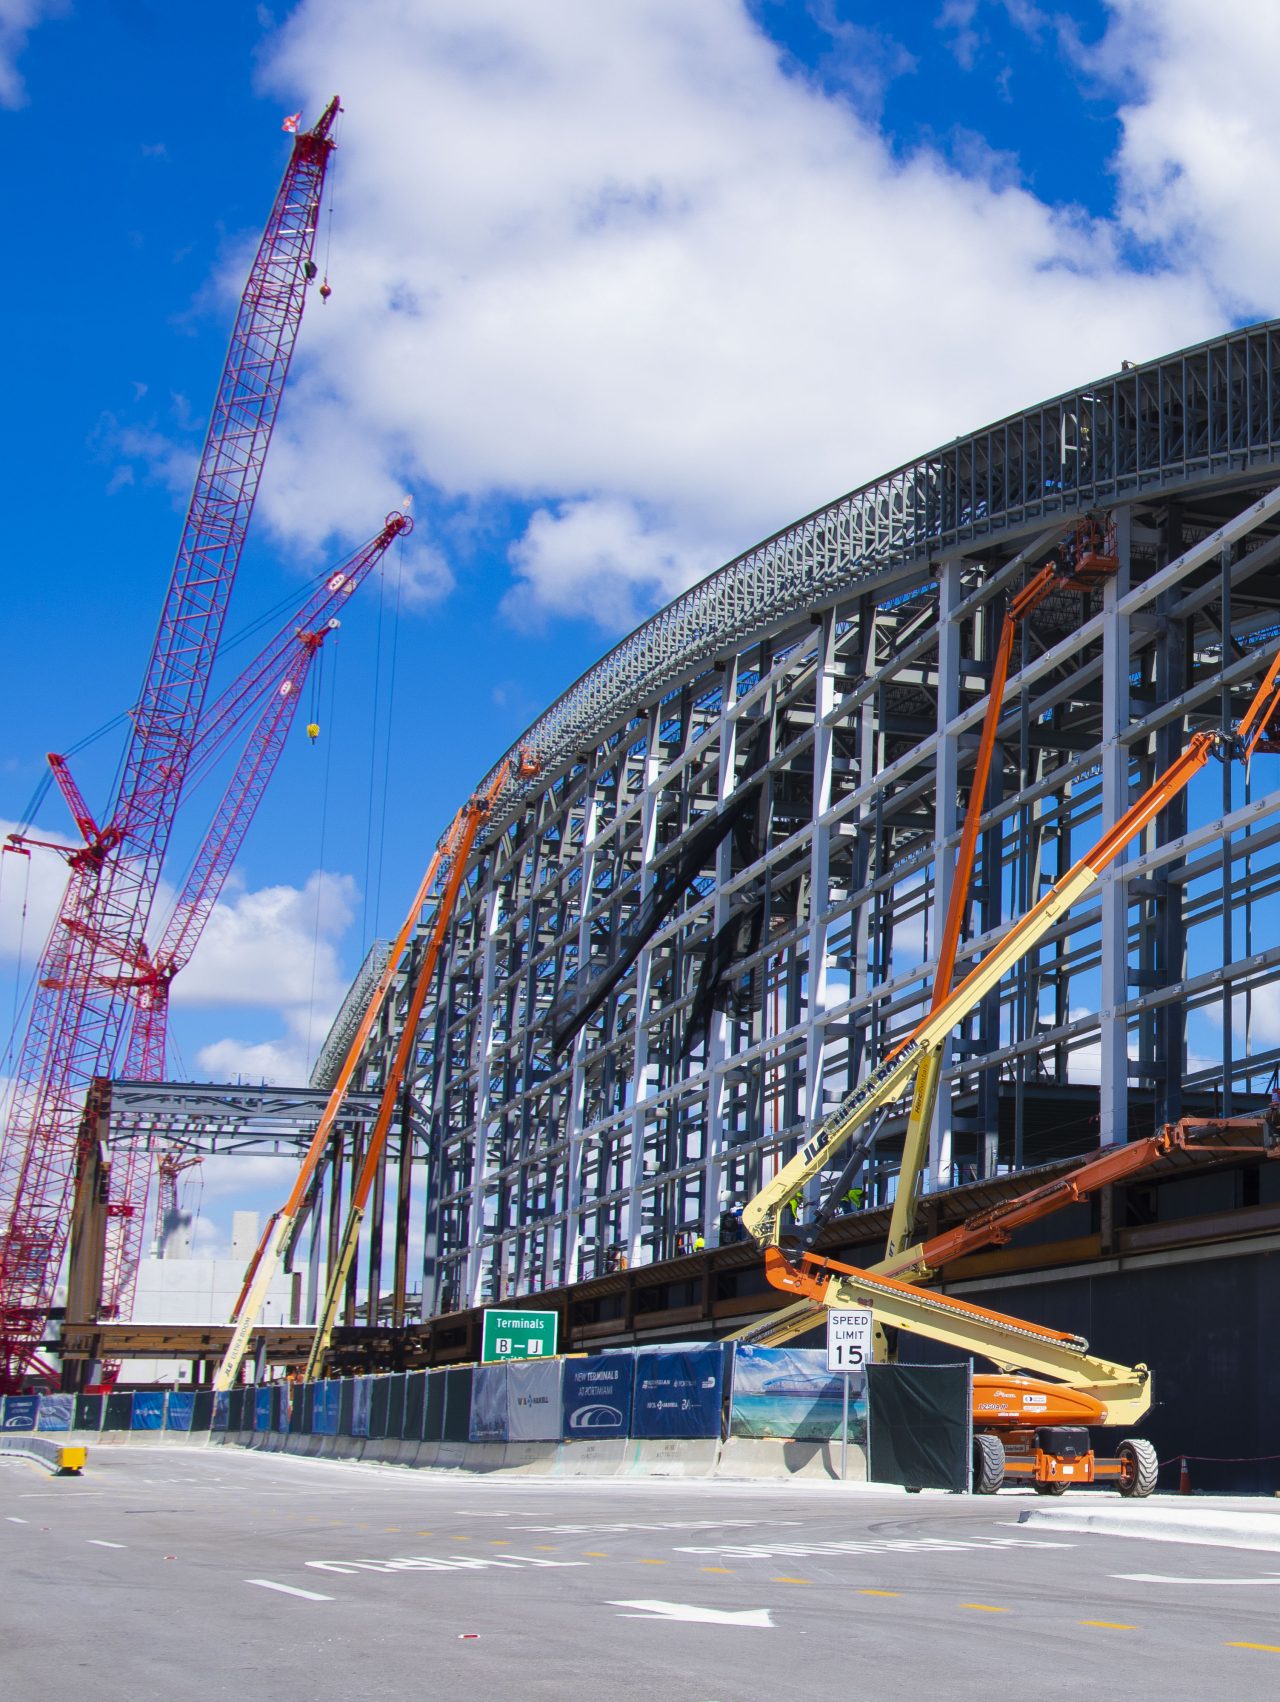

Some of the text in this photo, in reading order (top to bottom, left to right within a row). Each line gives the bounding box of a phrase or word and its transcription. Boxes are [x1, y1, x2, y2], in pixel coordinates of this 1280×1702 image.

[496, 1318, 544, 1329] Terminals
[832, 1316, 868, 1325] SPEED
[836, 1331, 864, 1339] LIMIT
[500, 1339, 508, 1353] B
[532, 1340, 539, 1354] J
[836, 1345, 863, 1365] 15
[672, 1536, 1079, 1559] PARKING
[304, 1555, 590, 1574] THRU
